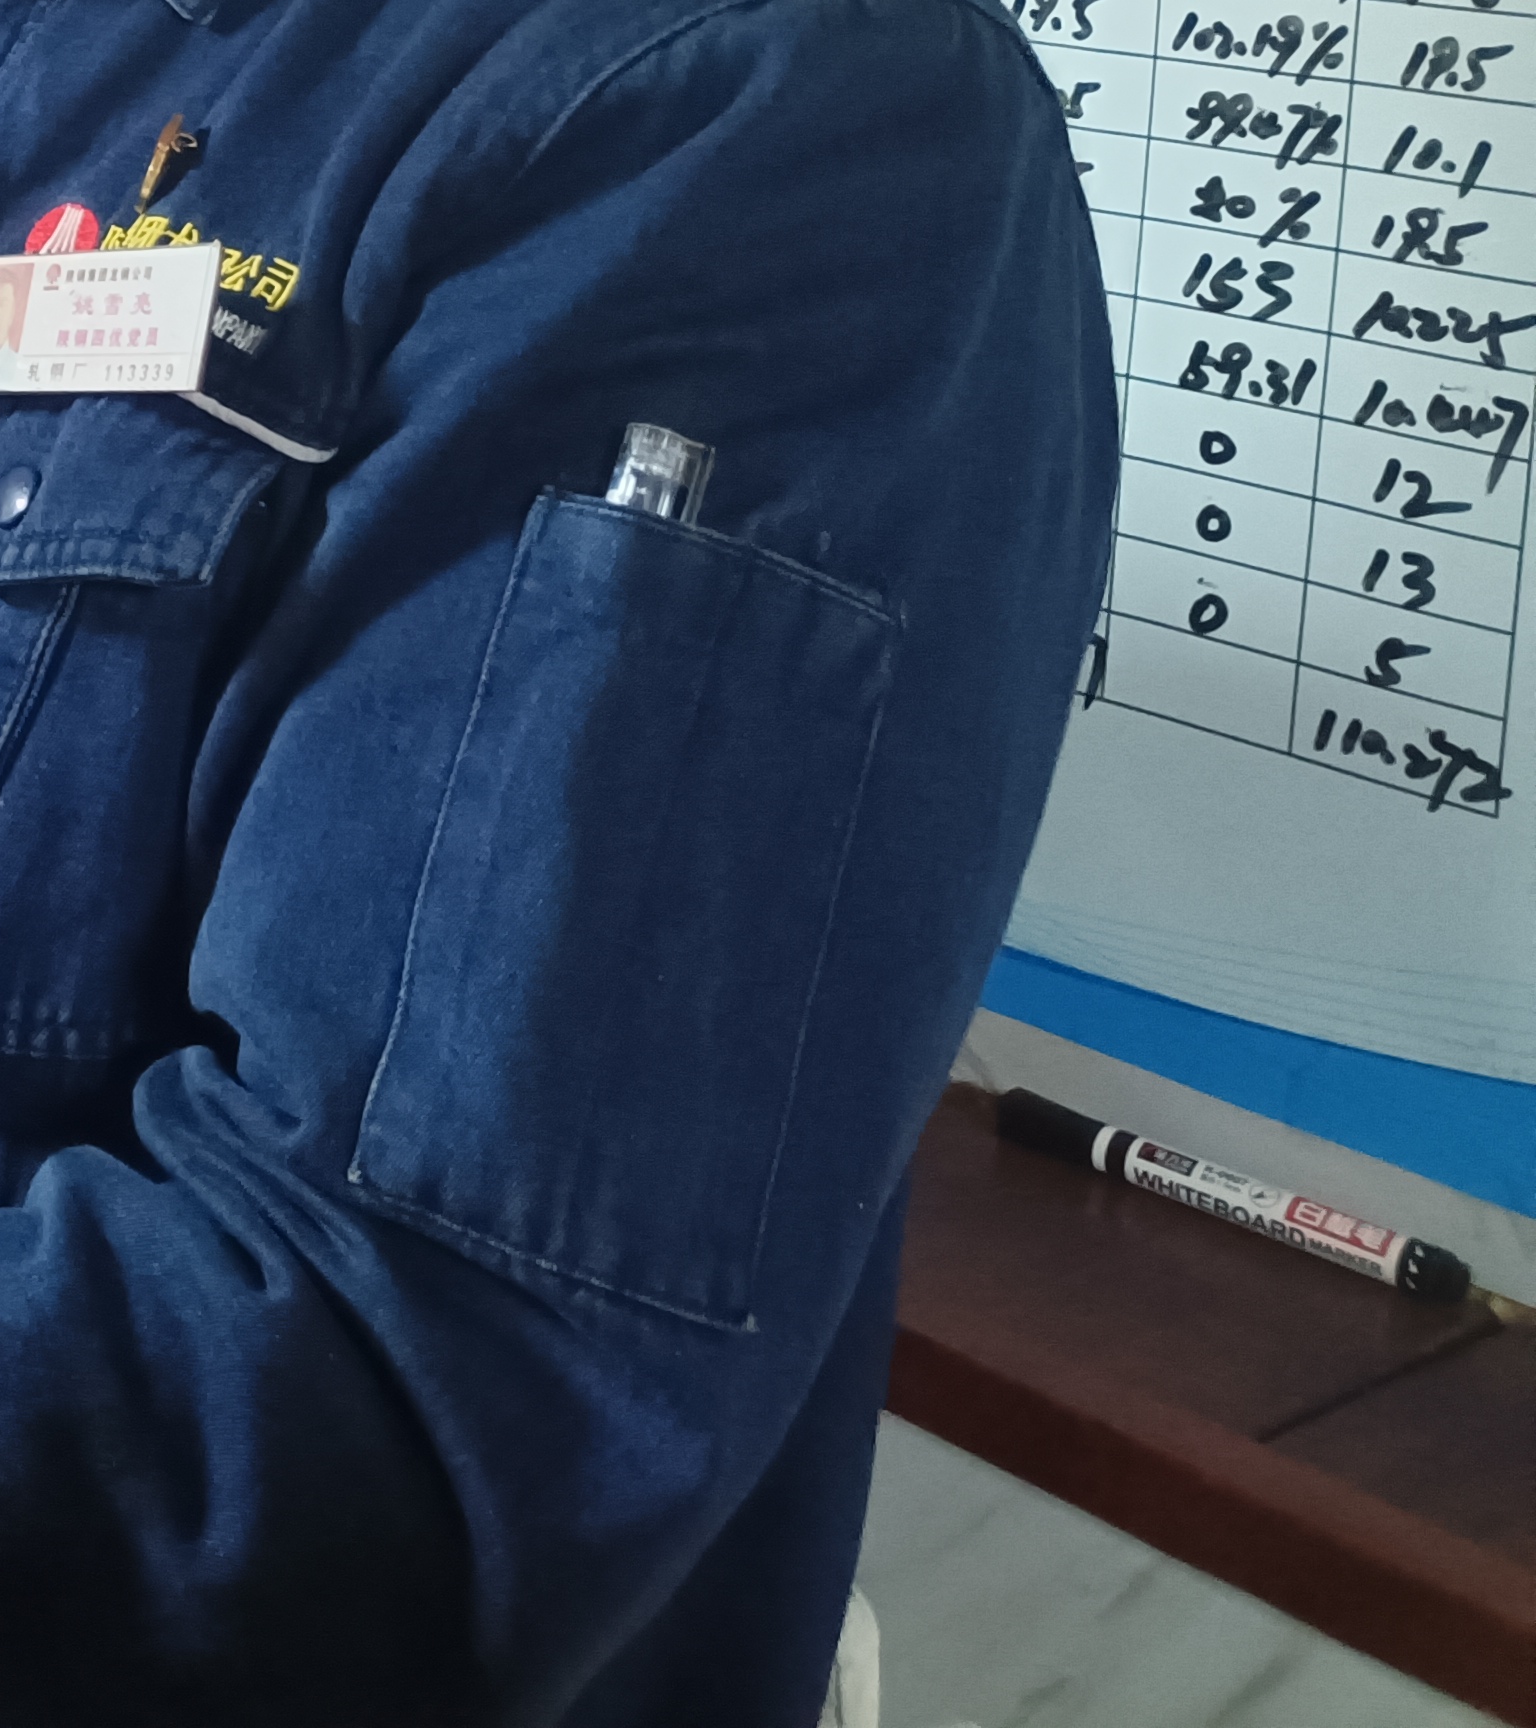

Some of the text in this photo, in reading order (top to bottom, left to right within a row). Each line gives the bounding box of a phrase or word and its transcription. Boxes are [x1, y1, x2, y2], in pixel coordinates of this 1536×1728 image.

[1384, 125, 1493, 199] 10.1
[1182, 253, 1295, 321] 153
[1199, 430, 1237, 465] 0
[1373, 458, 1473, 519] 12
[1196, 504, 1231, 542] 0
[1362, 549, 1436, 610] 13
[1188, 594, 1229, 634] 0
[1364, 637, 1431, 687] 5
[1132, 1167, 1307, 1251] WHITEBOARD
